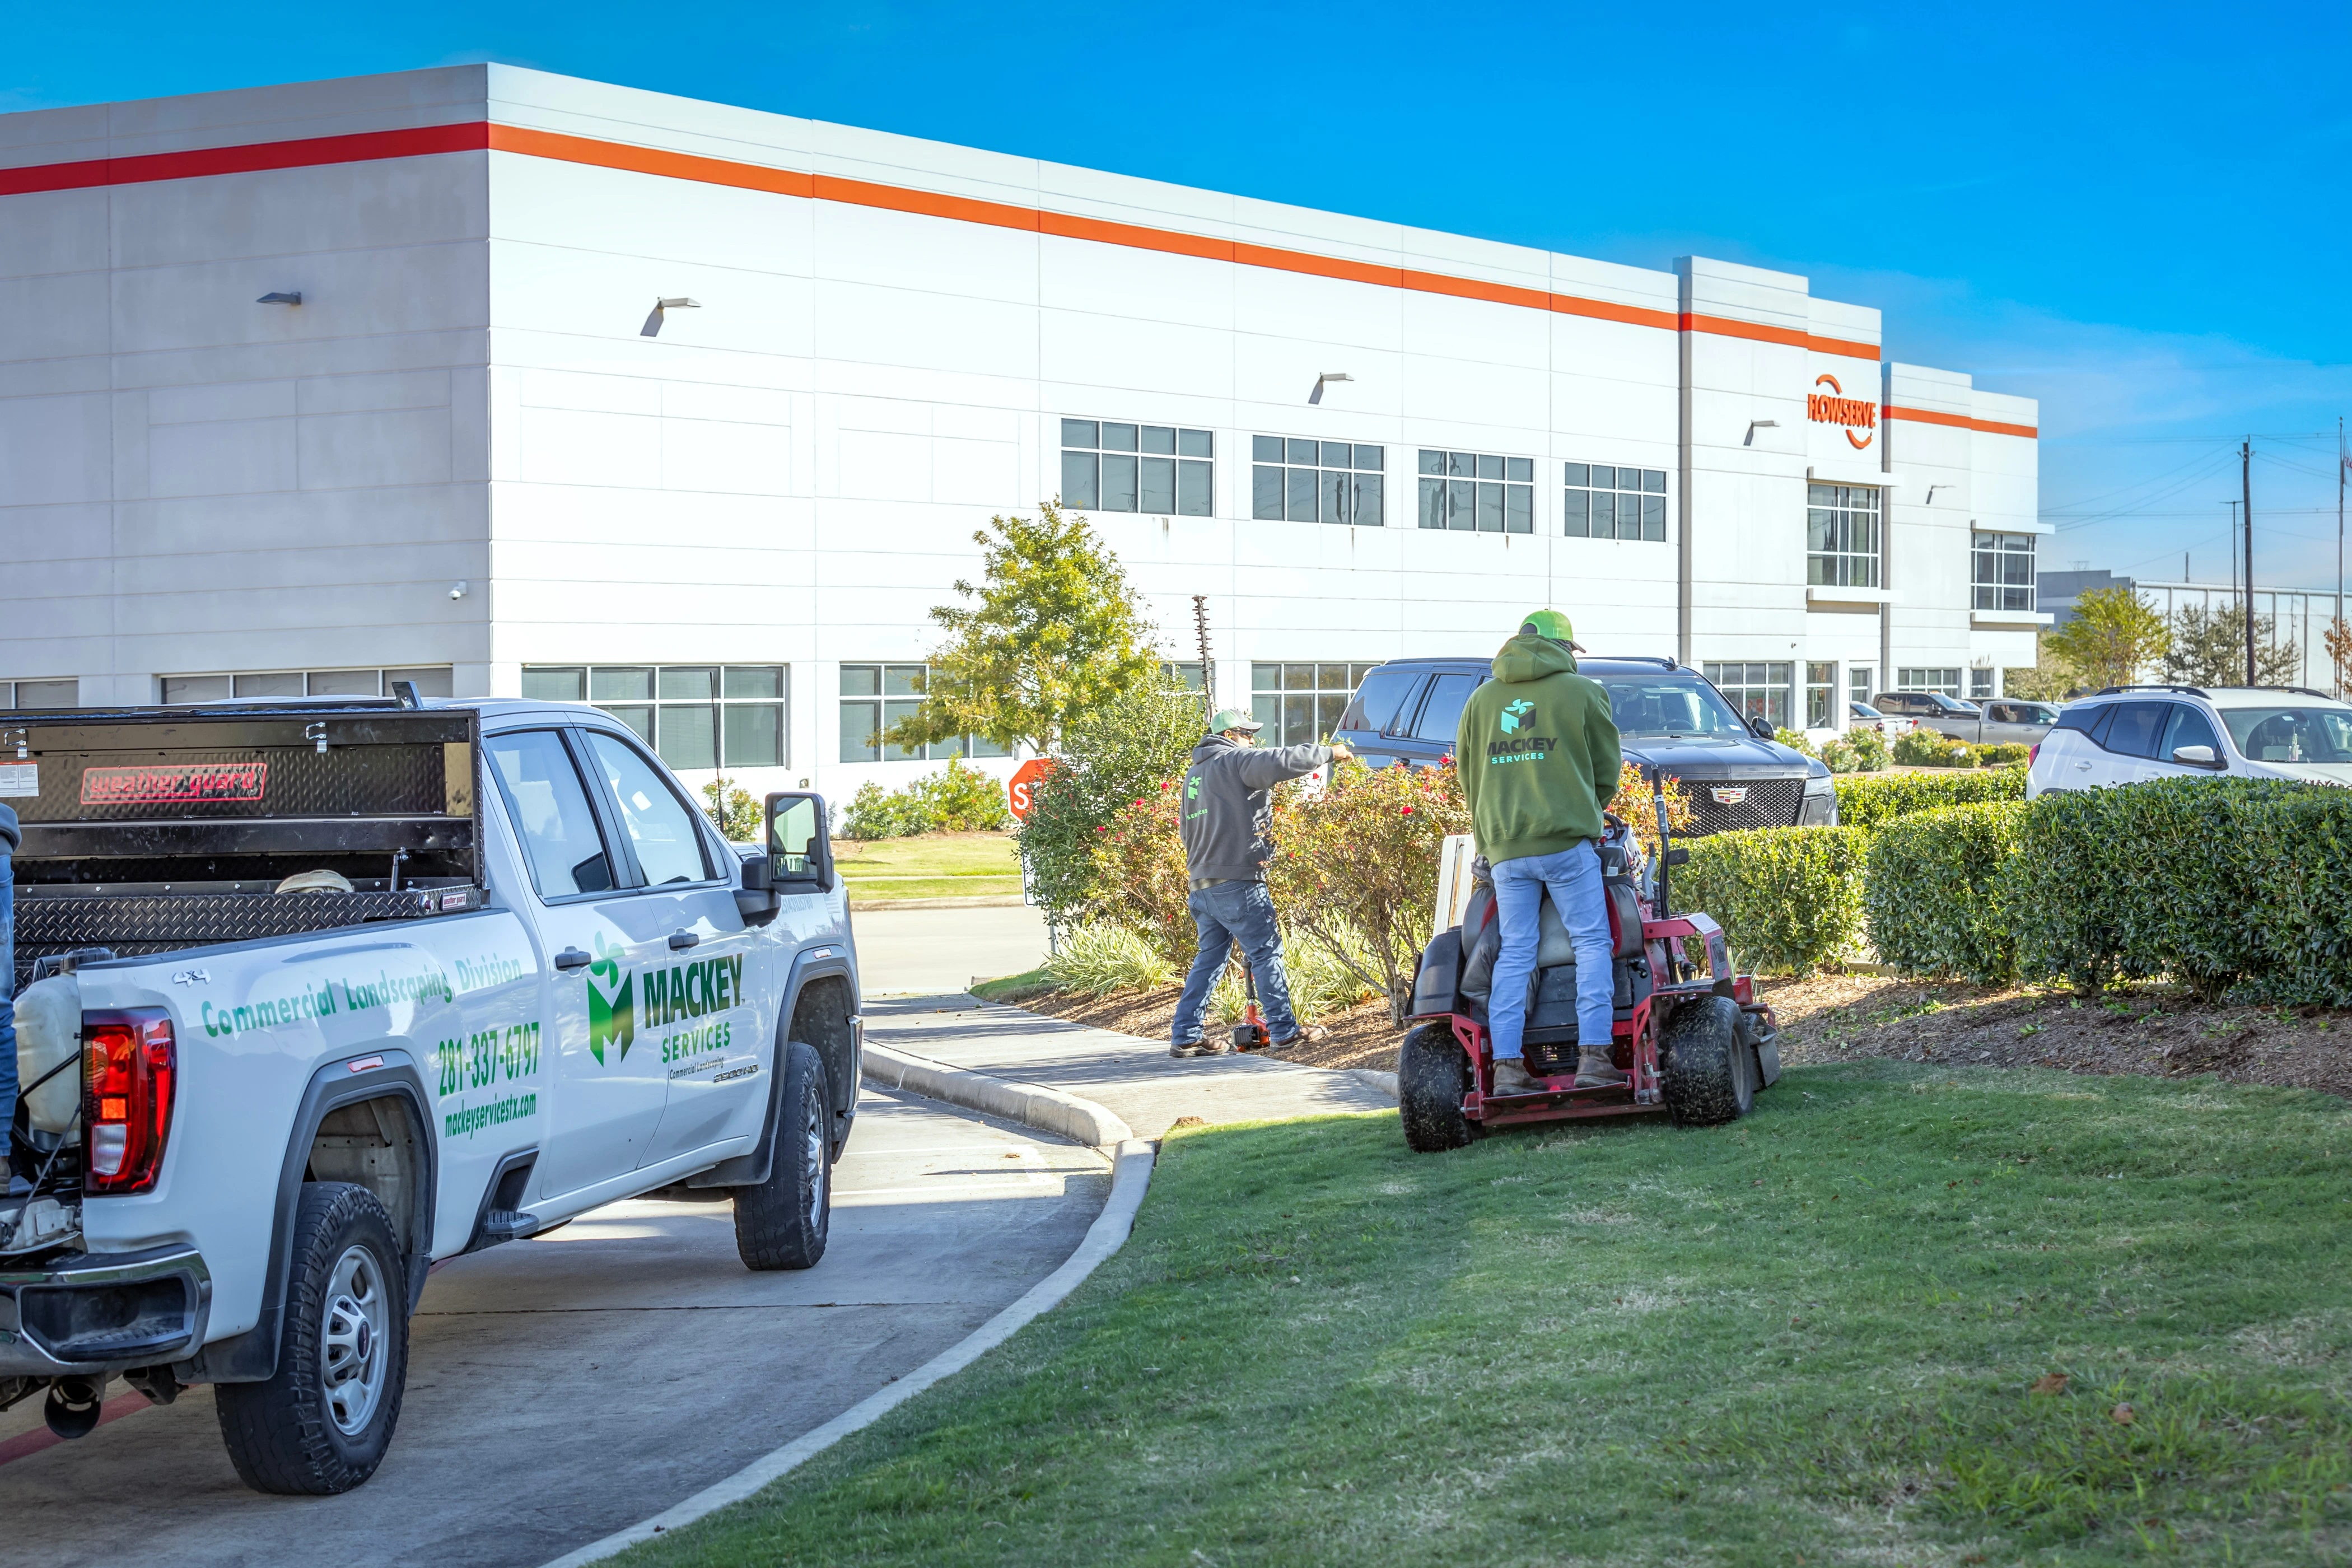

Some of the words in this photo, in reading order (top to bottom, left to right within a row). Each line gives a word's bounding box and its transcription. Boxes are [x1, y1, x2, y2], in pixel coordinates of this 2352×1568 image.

[1808, 394, 1875, 428] FLOWSERVE
[1487, 738, 1558, 756] MACKEY
[1491, 752, 1544, 764] SERVICES
[90, 771, 183, 793] weather
[189, 769, 255, 795] guard
[201, 978, 337, 1038] Commercial
[343, 964, 452, 1010] Landscaping
[455, 953, 522, 991] Division
[643, 953, 743, 1029] MACKEY
[439, 1021, 539, 1096] 281-337-6797
[662, 1021, 730, 1063] SERVICES
[670, 1063, 696, 1080] Commercial
[697, 1056, 724, 1072] Landscaping
[445, 1093, 536, 1140] mackeyservicestx.com
